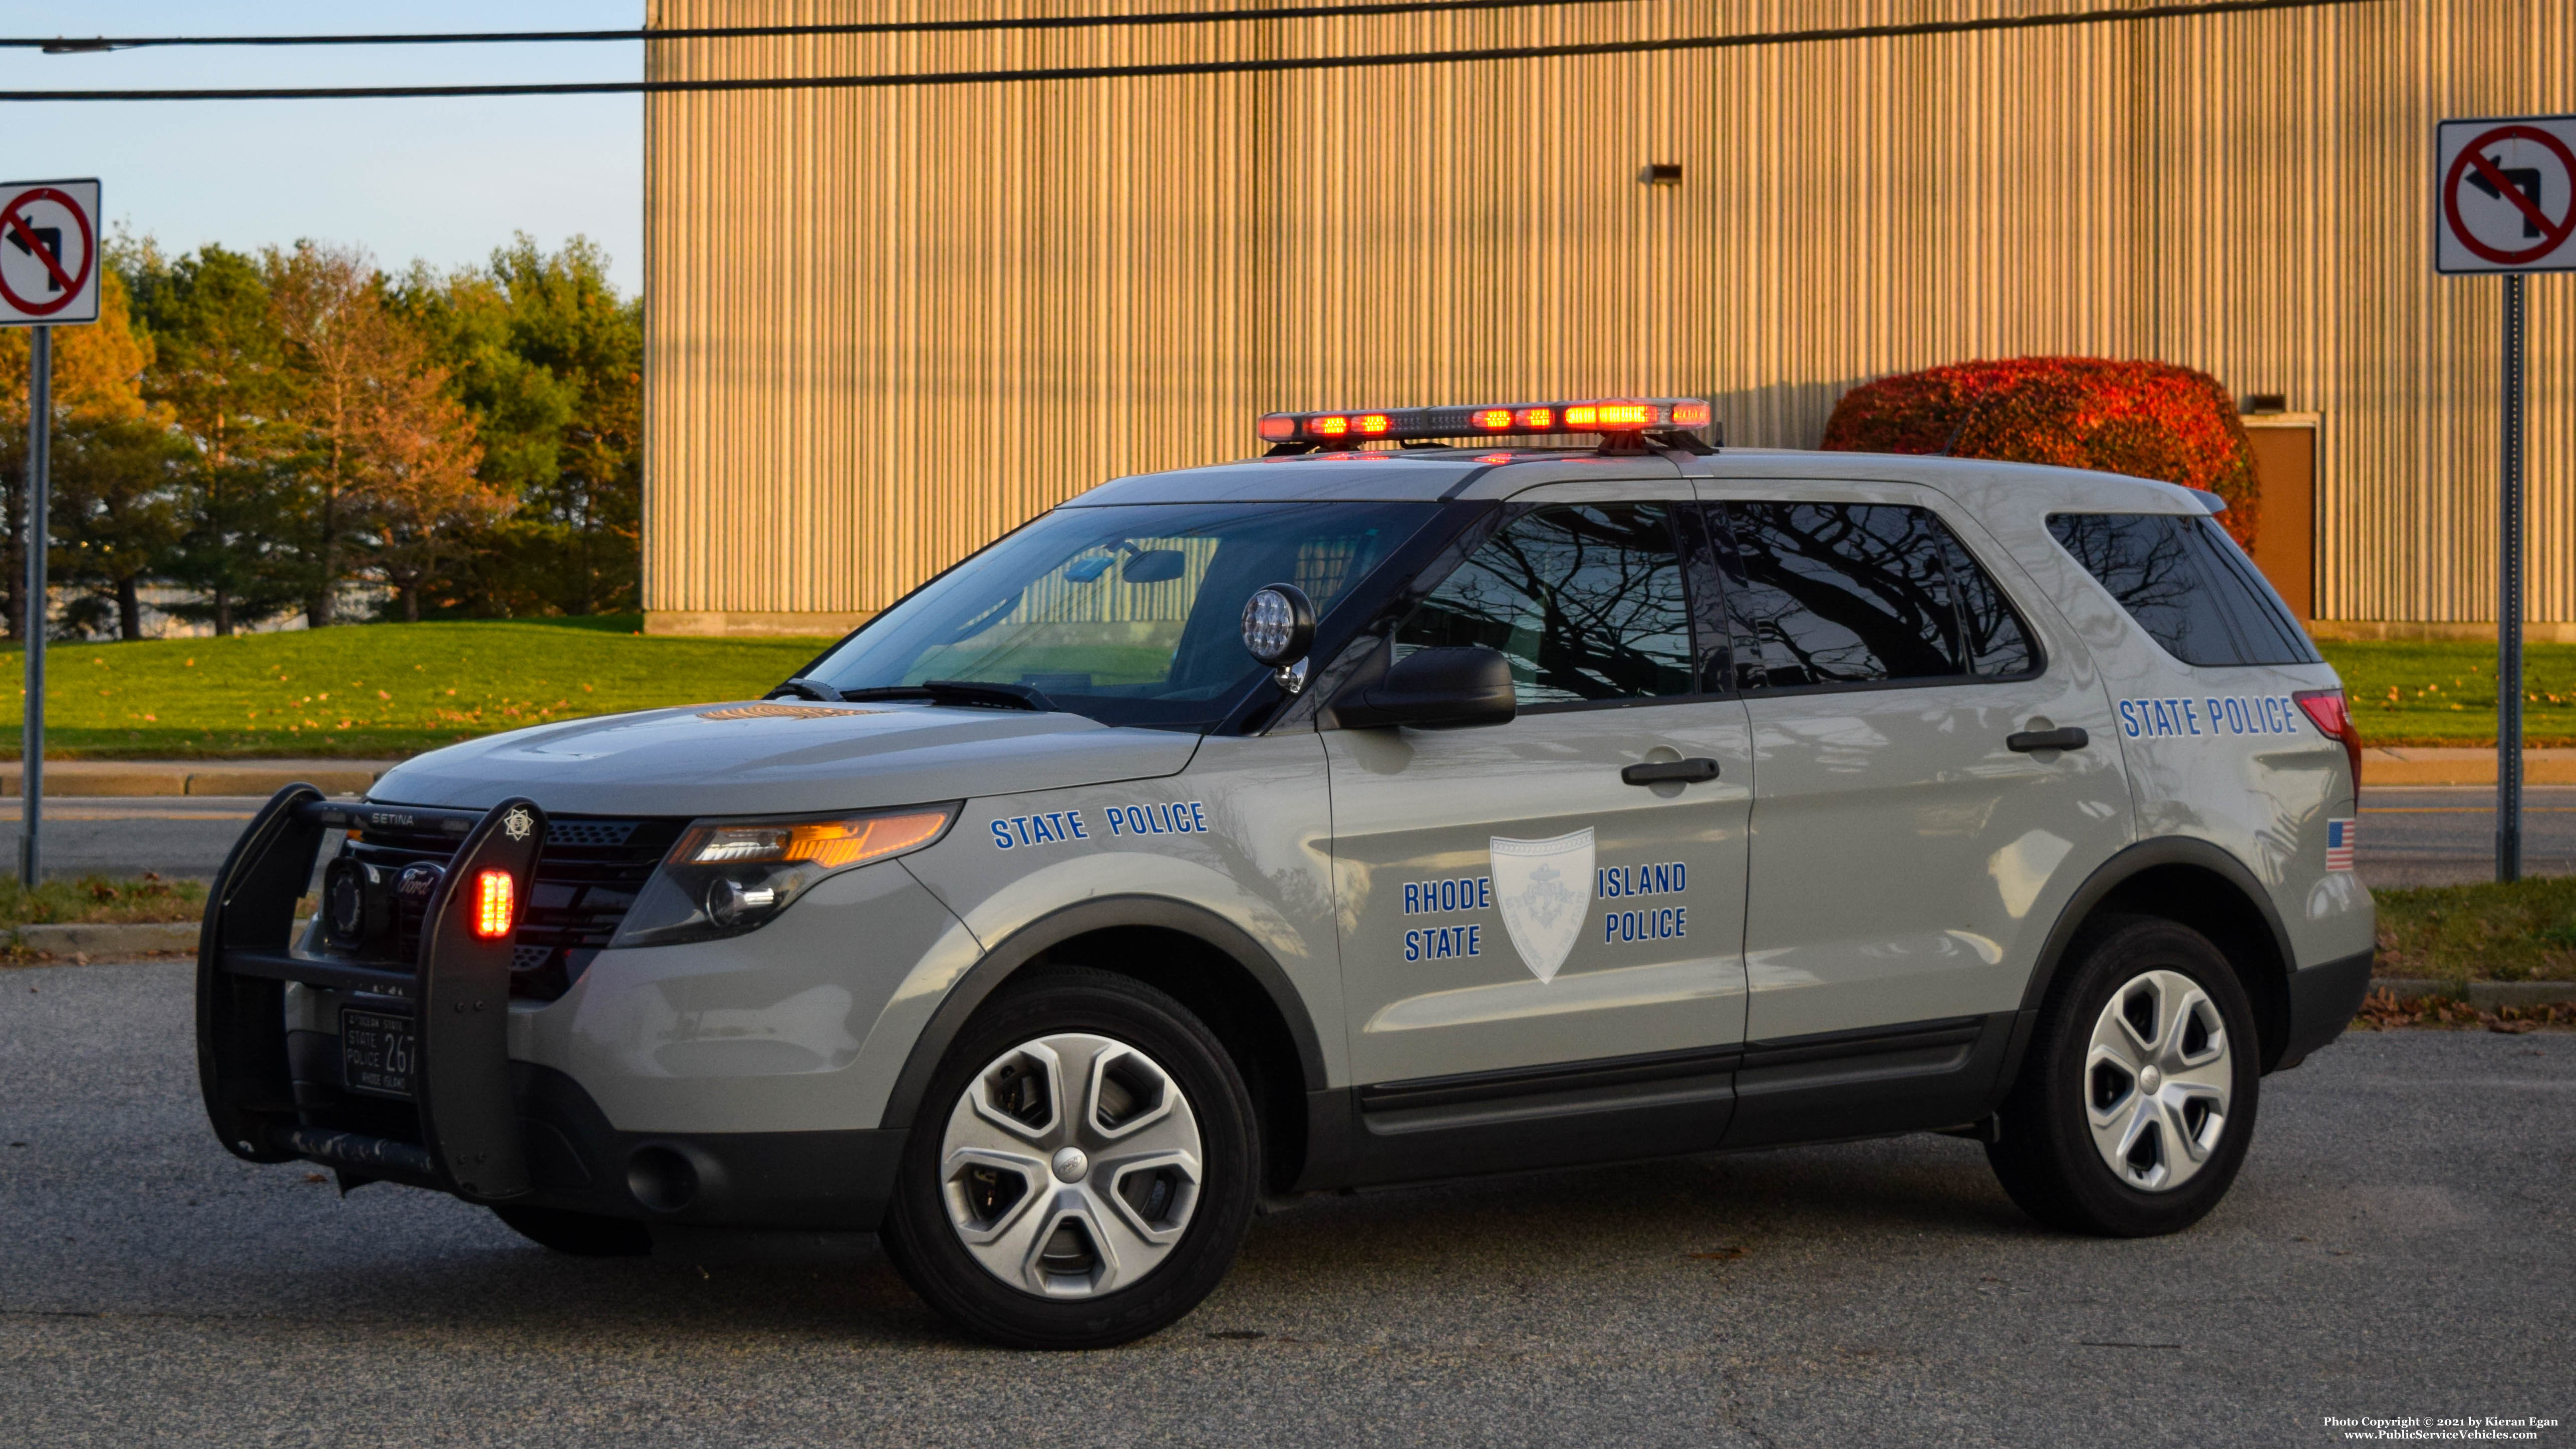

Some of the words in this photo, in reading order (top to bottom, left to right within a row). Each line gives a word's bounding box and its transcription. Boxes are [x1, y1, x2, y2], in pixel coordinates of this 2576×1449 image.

[2119, 697, 2203, 739] STATE
[2205, 695, 2299, 736] POLICE
[372, 812, 414, 826] SETINA
[990, 809, 1090, 850] STATE
[1104, 801, 1209, 837] POLICE
[400, 868, 434, 895] Ford
[1403, 876, 1490, 915] RHODE
[1597, 861, 1686, 899] ISLAND
[1404, 924, 1481, 962] STATE
[1605, 906, 1686, 945] POLICE
[347, 1047, 380, 1067] POLICE
[349, 1029, 377, 1048] STATE
[385, 1033, 415, 1074] 267
